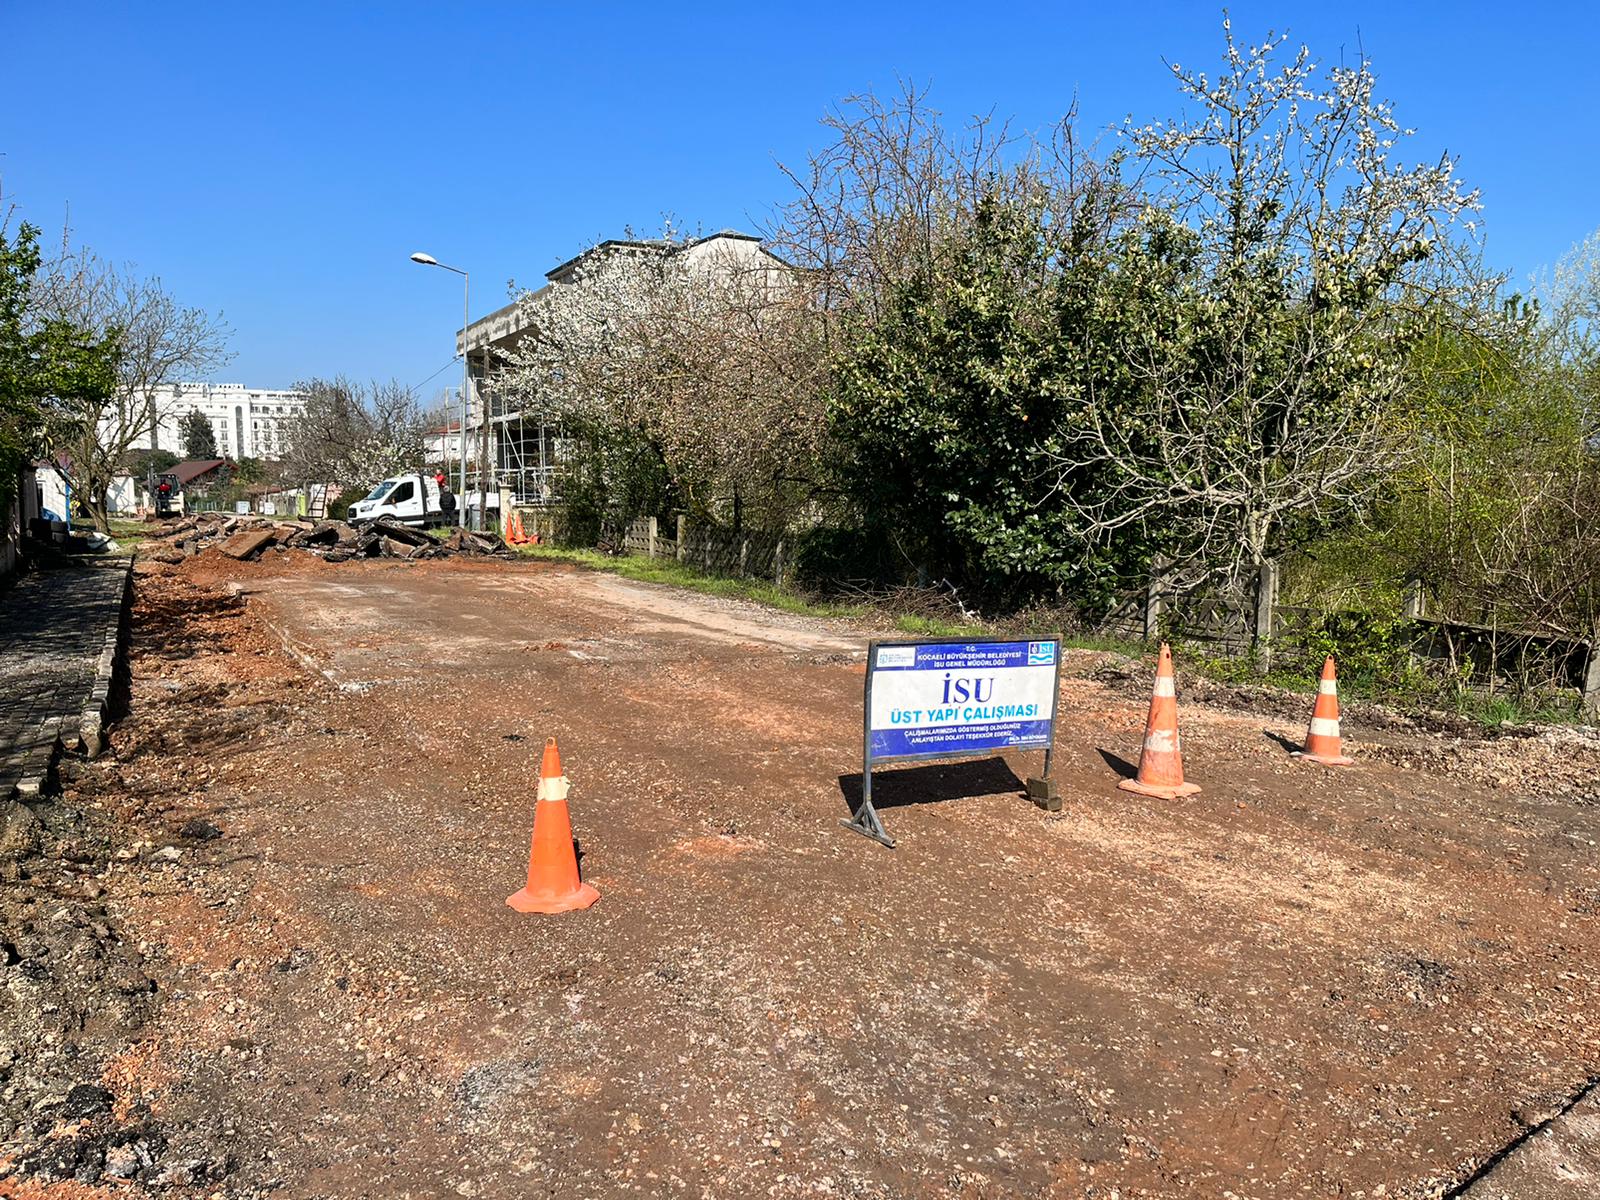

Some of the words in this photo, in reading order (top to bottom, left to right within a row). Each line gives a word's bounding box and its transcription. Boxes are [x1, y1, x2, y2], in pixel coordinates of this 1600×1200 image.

[946, 652, 986, 660] BÜYÜKŞEHİR
[987, 651, 1022, 659] BELEDİYESİ
[941, 673, 995, 703] İSU
[890, 708, 922, 724] ÜST
[927, 708, 958, 722] YAPI
[963, 704, 1038, 722] ÇALIŞMASI
[904, 728, 957, 737] ÇALIŞMALARIMIZDA
[965, 731, 993, 740] TEŞEKKÜR
